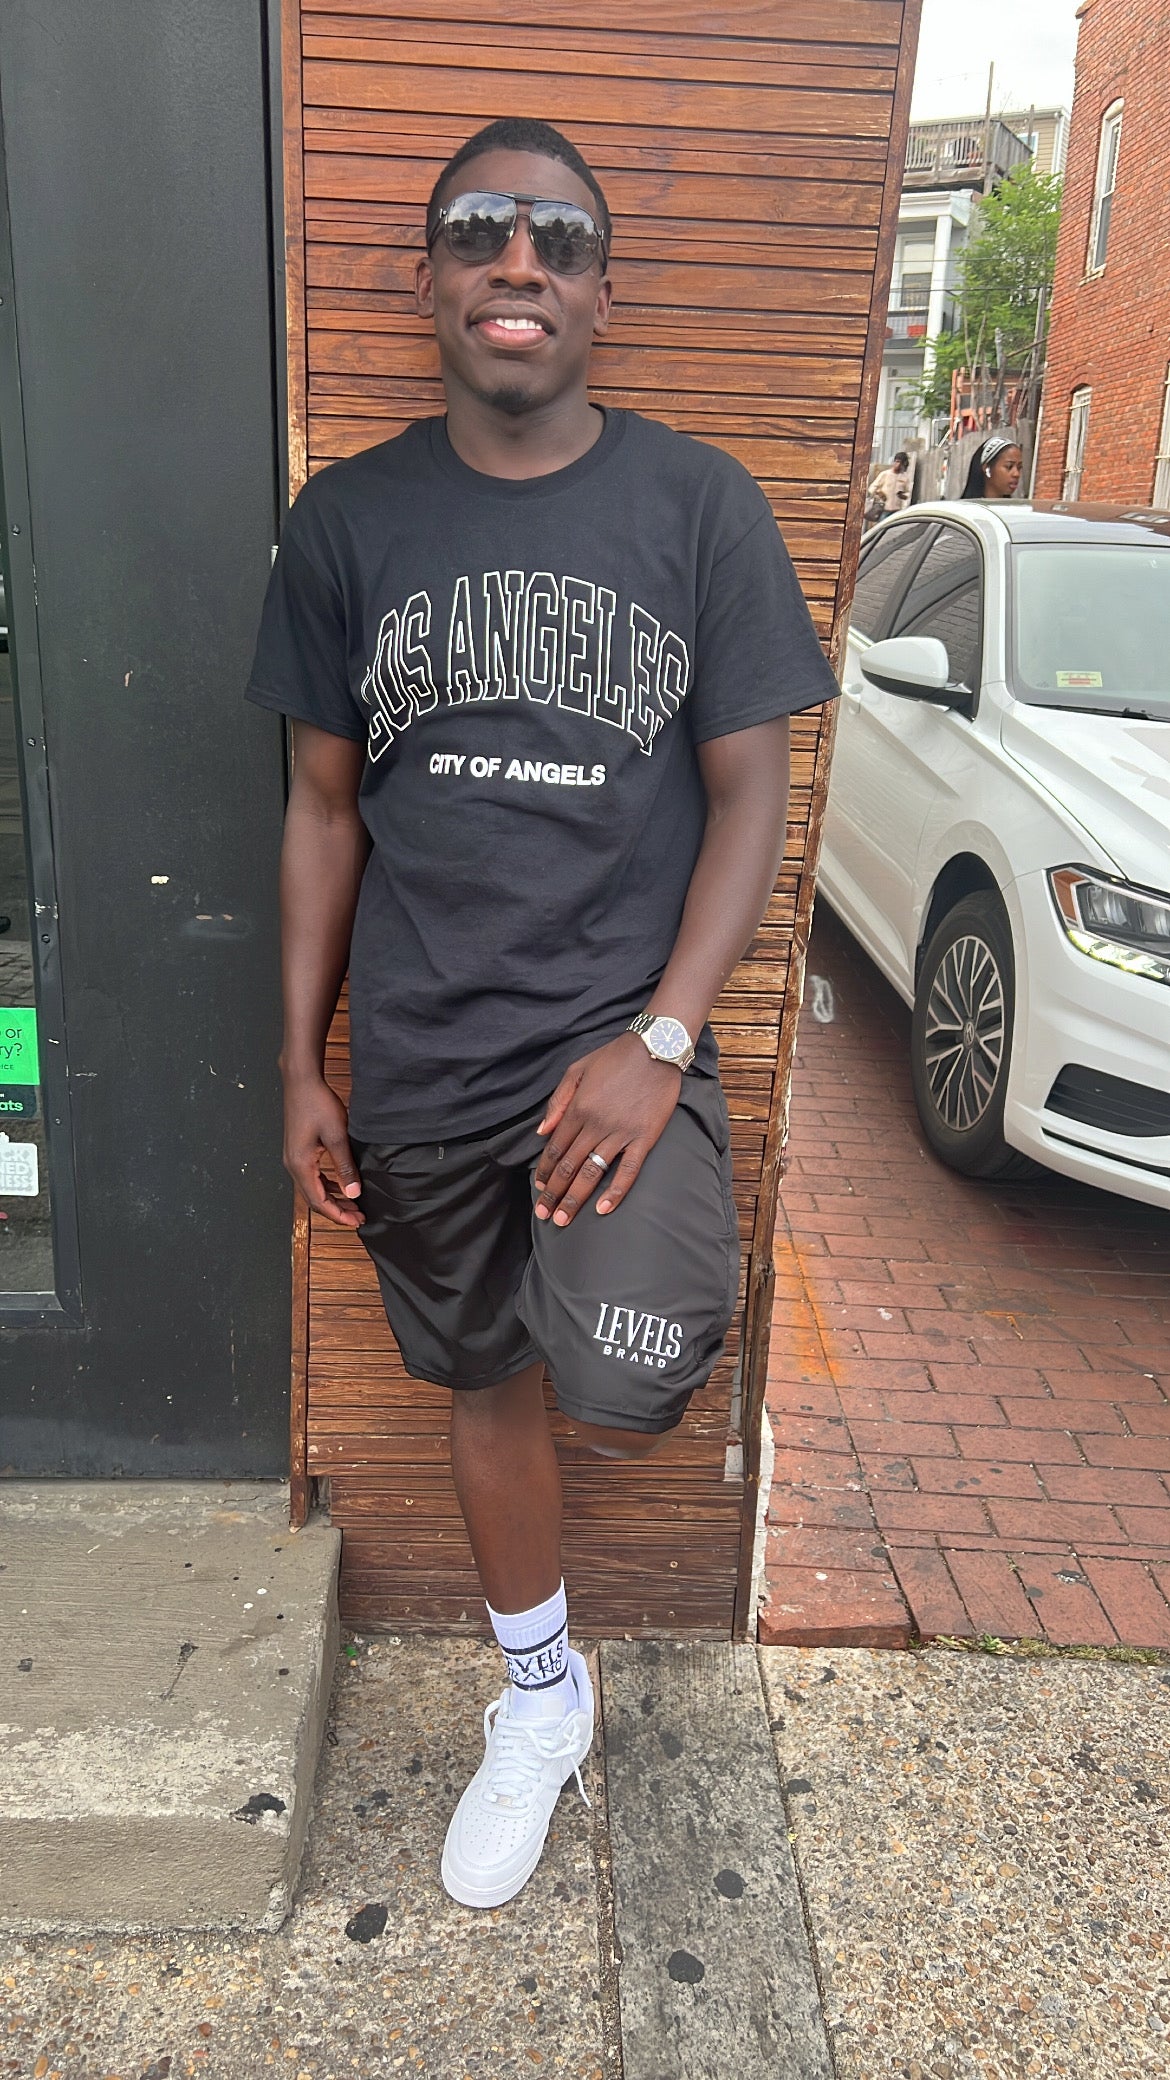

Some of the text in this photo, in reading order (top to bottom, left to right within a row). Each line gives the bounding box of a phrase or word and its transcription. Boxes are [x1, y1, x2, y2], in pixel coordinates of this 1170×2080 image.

[447, 569, 690, 757] ANGELES
[429, 753, 606, 786] CITY OF ANGELS
[0, 1042, 23, 1059] ry?
[0, 1100, 24, 1111] ats
[593, 1303, 683, 1359] LEVELS
[603, 1345, 667, 1369] BRAND
[504, 1640, 563, 1674] EVELS
[508, 1660, 562, 1682] RAND
